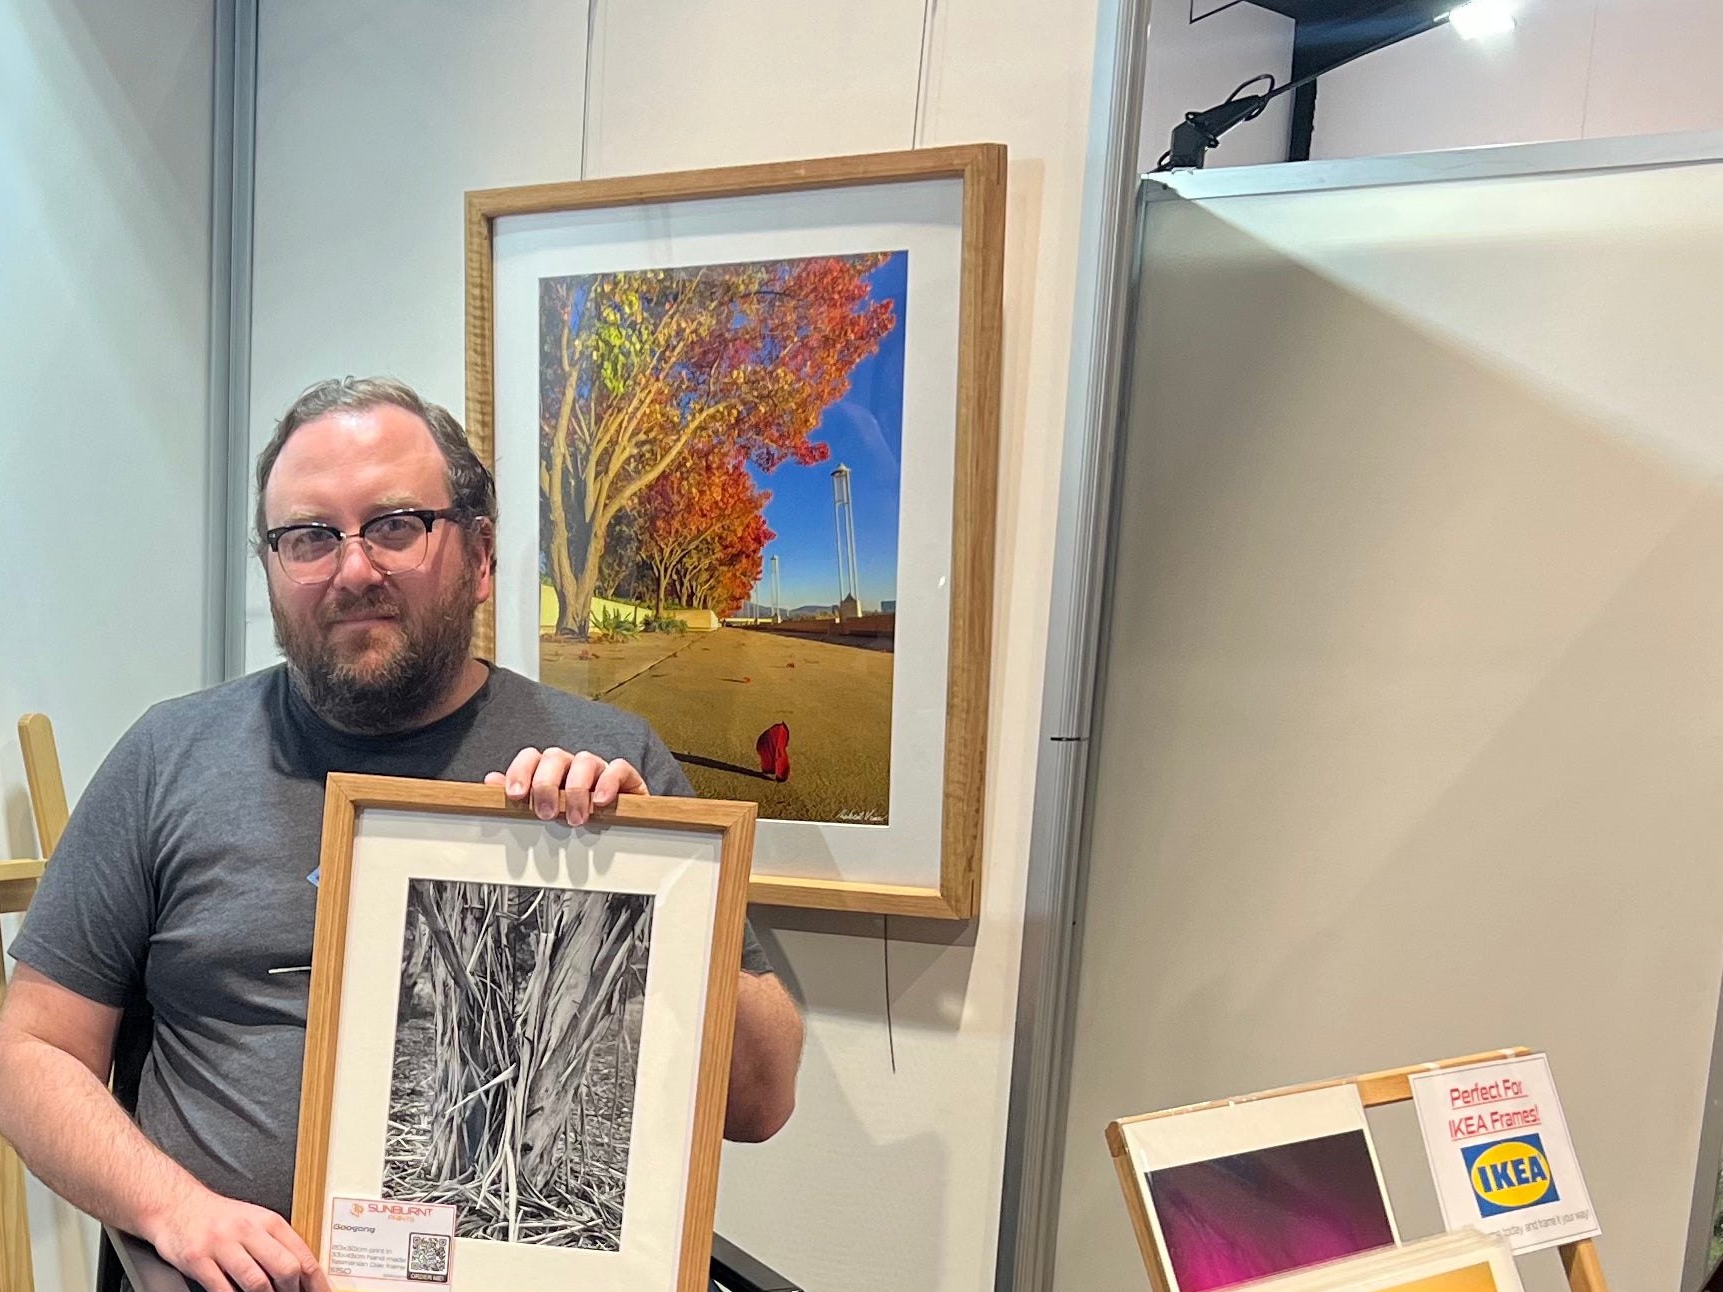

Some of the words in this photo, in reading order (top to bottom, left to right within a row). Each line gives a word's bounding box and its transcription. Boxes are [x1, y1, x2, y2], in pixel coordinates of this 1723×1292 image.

[1449, 1081, 1500, 1108] Perfect
[1502, 1077, 1524, 1100] For
[1449, 1115, 1489, 1140] IKEA
[1491, 1104, 1541, 1131] Frames!
[1477, 1156, 1548, 1194] IKEA
[368, 1203, 433, 1217] SUNBURNT
